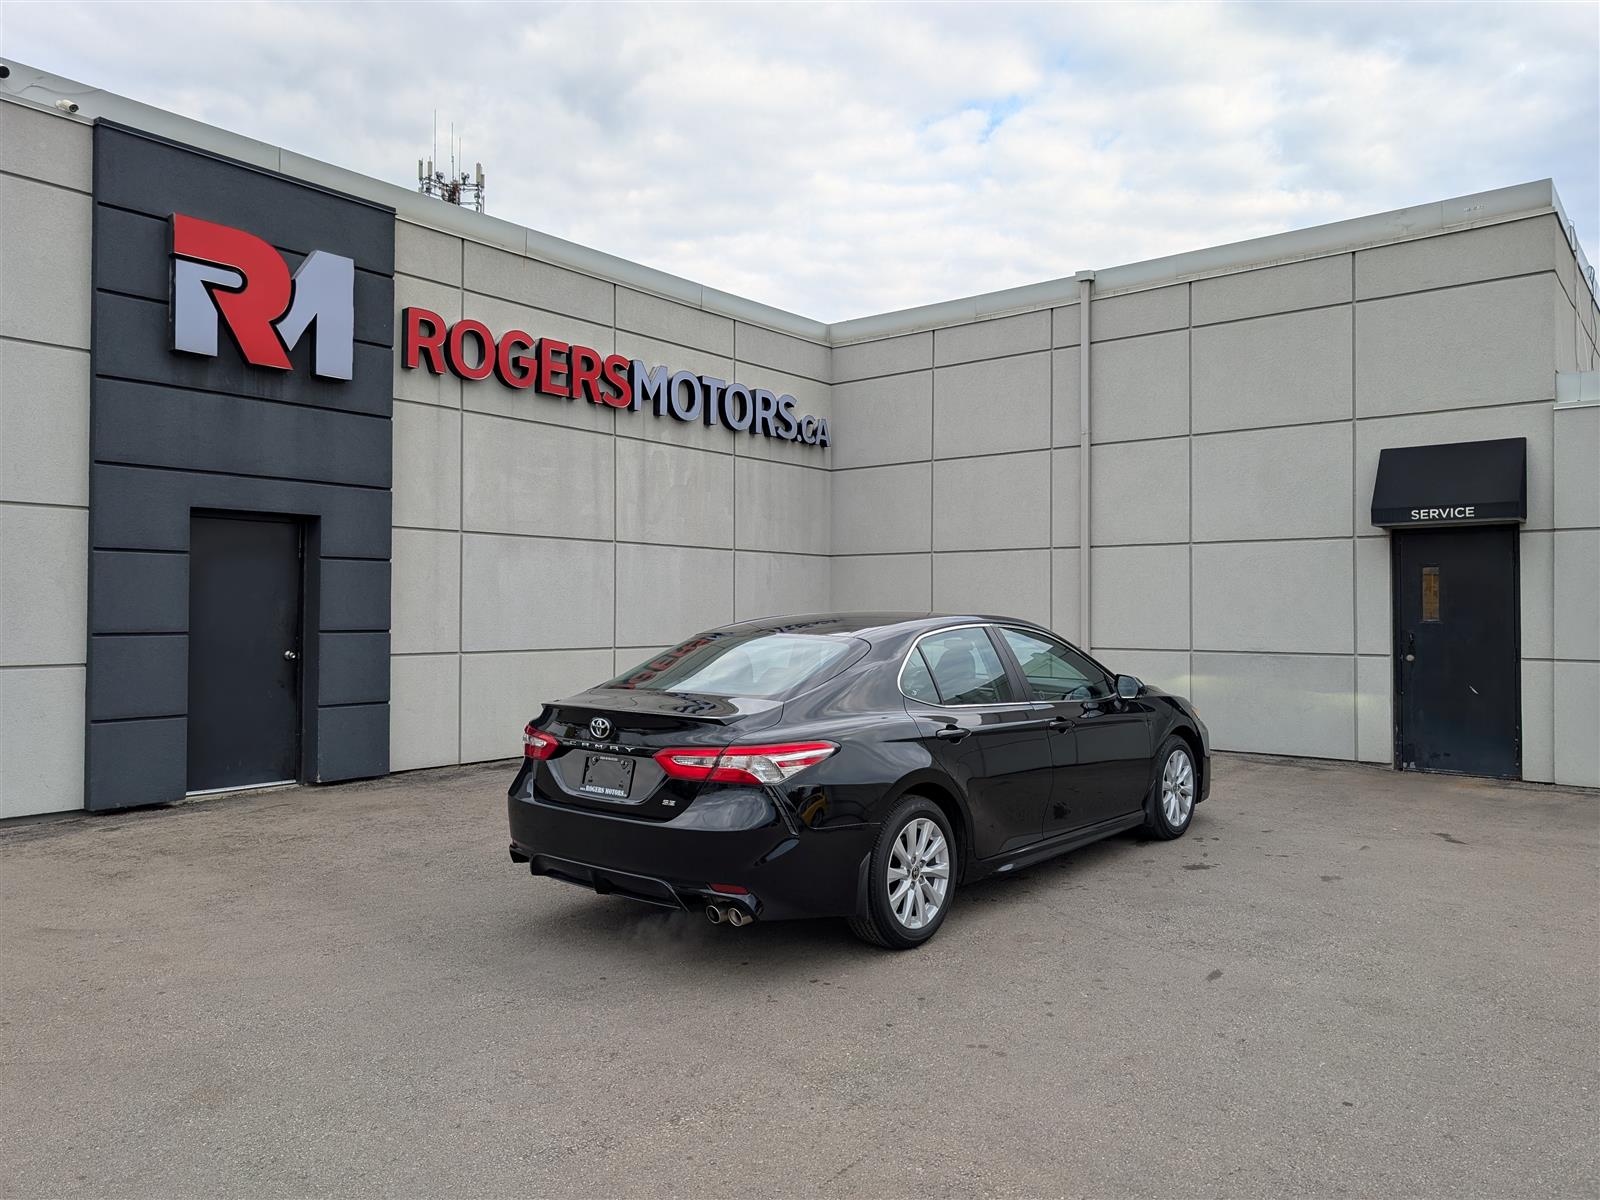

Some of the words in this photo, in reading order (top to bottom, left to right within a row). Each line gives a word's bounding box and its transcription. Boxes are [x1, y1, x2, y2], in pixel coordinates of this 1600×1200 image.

[171, 212, 355, 381] RM
[1411, 506, 1475, 520] SERVICE
[569, 740, 635, 752] CAMRY
[585, 785, 605, 793] ROGERS
